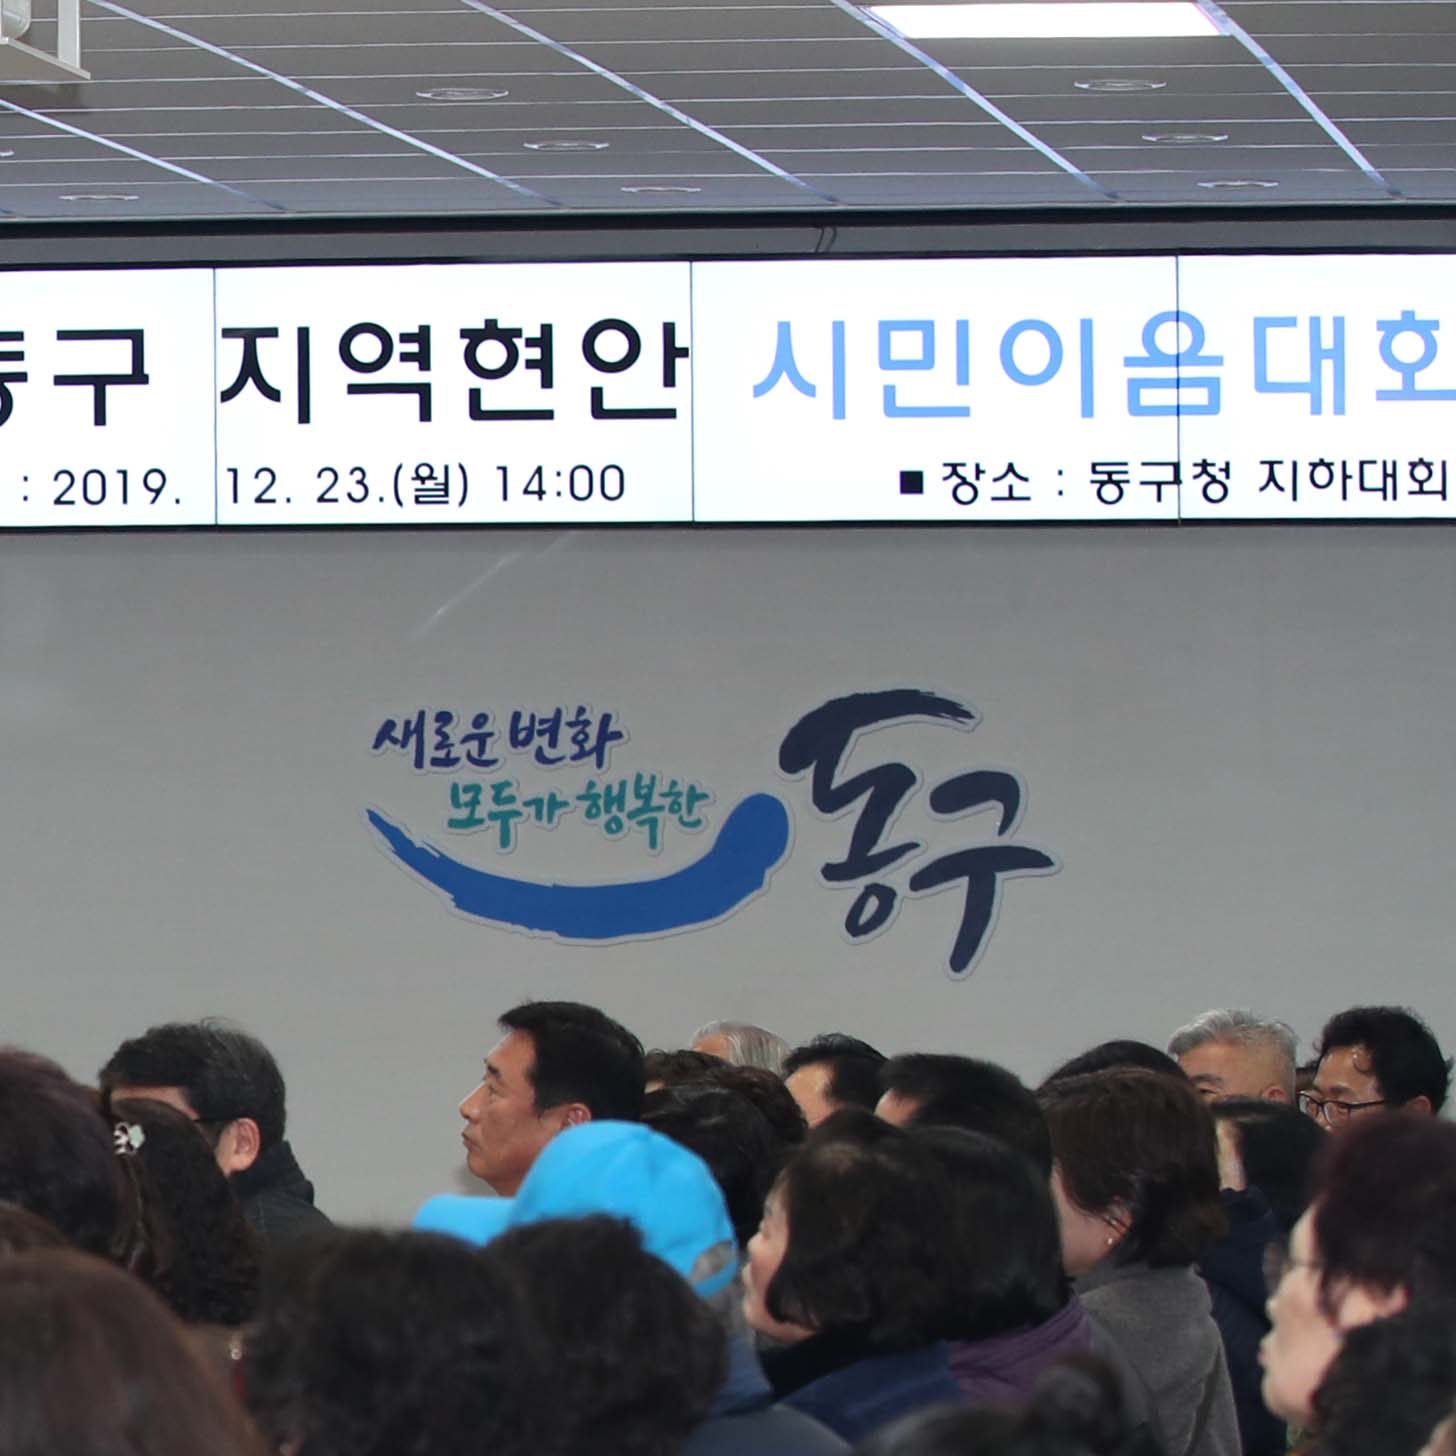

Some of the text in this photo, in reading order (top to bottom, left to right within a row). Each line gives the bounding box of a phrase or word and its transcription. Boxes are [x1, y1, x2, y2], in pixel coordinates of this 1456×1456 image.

[220, 317, 690, 426] 지역현안
[53, 467, 182, 506] 2019.
[226, 467, 292, 504] 12.
[316, 462, 469, 508] 23.(월)
[496, 463, 625, 502] 14:00
[942, 461, 1032, 506] 장소
[1089, 458, 1232, 506] 동구청
[1258, 457, 1448, 502] 지하대회
[372, 709, 622, 769] 새로운 변화
[449, 774, 710, 850] 모두가 행복한
[778, 688, 1055, 974] 동구
